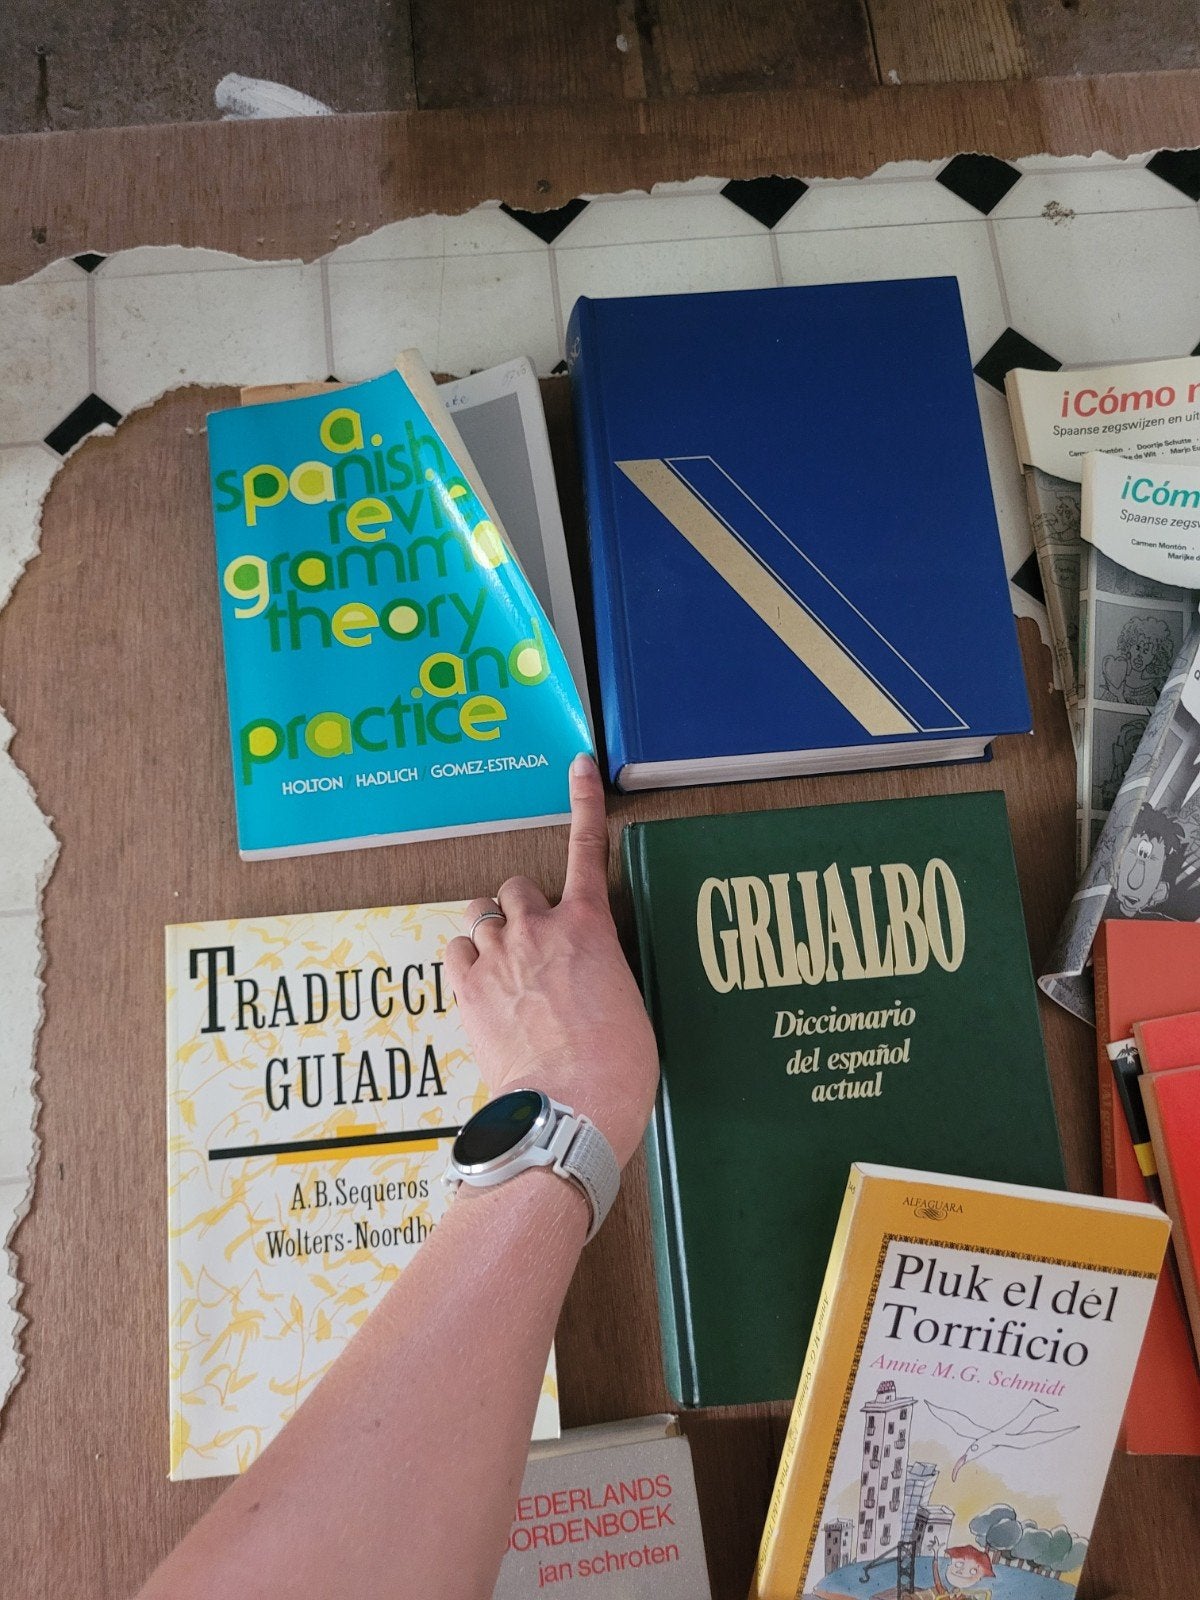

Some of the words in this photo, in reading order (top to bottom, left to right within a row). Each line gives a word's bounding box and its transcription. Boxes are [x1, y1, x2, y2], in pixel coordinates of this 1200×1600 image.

[1053, 425, 1099, 438] Spaanse
[1102, 416, 1165, 434] zegswijzen
[1168, 414, 1182, 424] en
[1136, 441, 1164, 452] Doortje
[1164, 438, 1192, 448] Schutte
[214, 420, 446, 527] spanish
[1121, 475, 1200, 508] ¡Cóm
[329, 467, 472, 544] revie
[1120, 509, 1168, 526] Spaanse
[1131, 538, 1157, 548] Carmen
[224, 520, 510, 619] gramma
[263, 587, 488, 654] theory
[419, 616, 551, 698] and
[240, 687, 507, 786] practice
[282, 776, 344, 796] HOLTON
[356, 767, 418, 788] HADLICH
[431, 753, 549, 779] GOMEZ-ESTRADA
[696, 857, 966, 994] GRIJALBO
[189, 946, 456, 1034] TRADUCCI
[772, 1000, 916, 1039] Diccionario
[265, 1044, 447, 1112] GUIADA
[786, 1050, 819, 1076] del
[827, 1038, 911, 1074] español
[811, 1071, 883, 1103] actual
[902, 1196, 964, 1213] ALFAGUARA
[266, 1215, 436, 1259] Wolters-Noordh
[889, 1253, 994, 1303] Pluk
[1003, 1274, 1043, 1311] el
[882, 1302, 1089, 1367] Torrificio
[870, 1354, 928, 1375] Annie
[988, 1369, 1066, 1397] Schmidt
[514, 1474, 673, 1521] EDERLANDS
[508, 1503, 676, 1551] ORDENBOEK
[538, 1560, 573, 1588] jan
[578, 1544, 680, 1577] schroten
